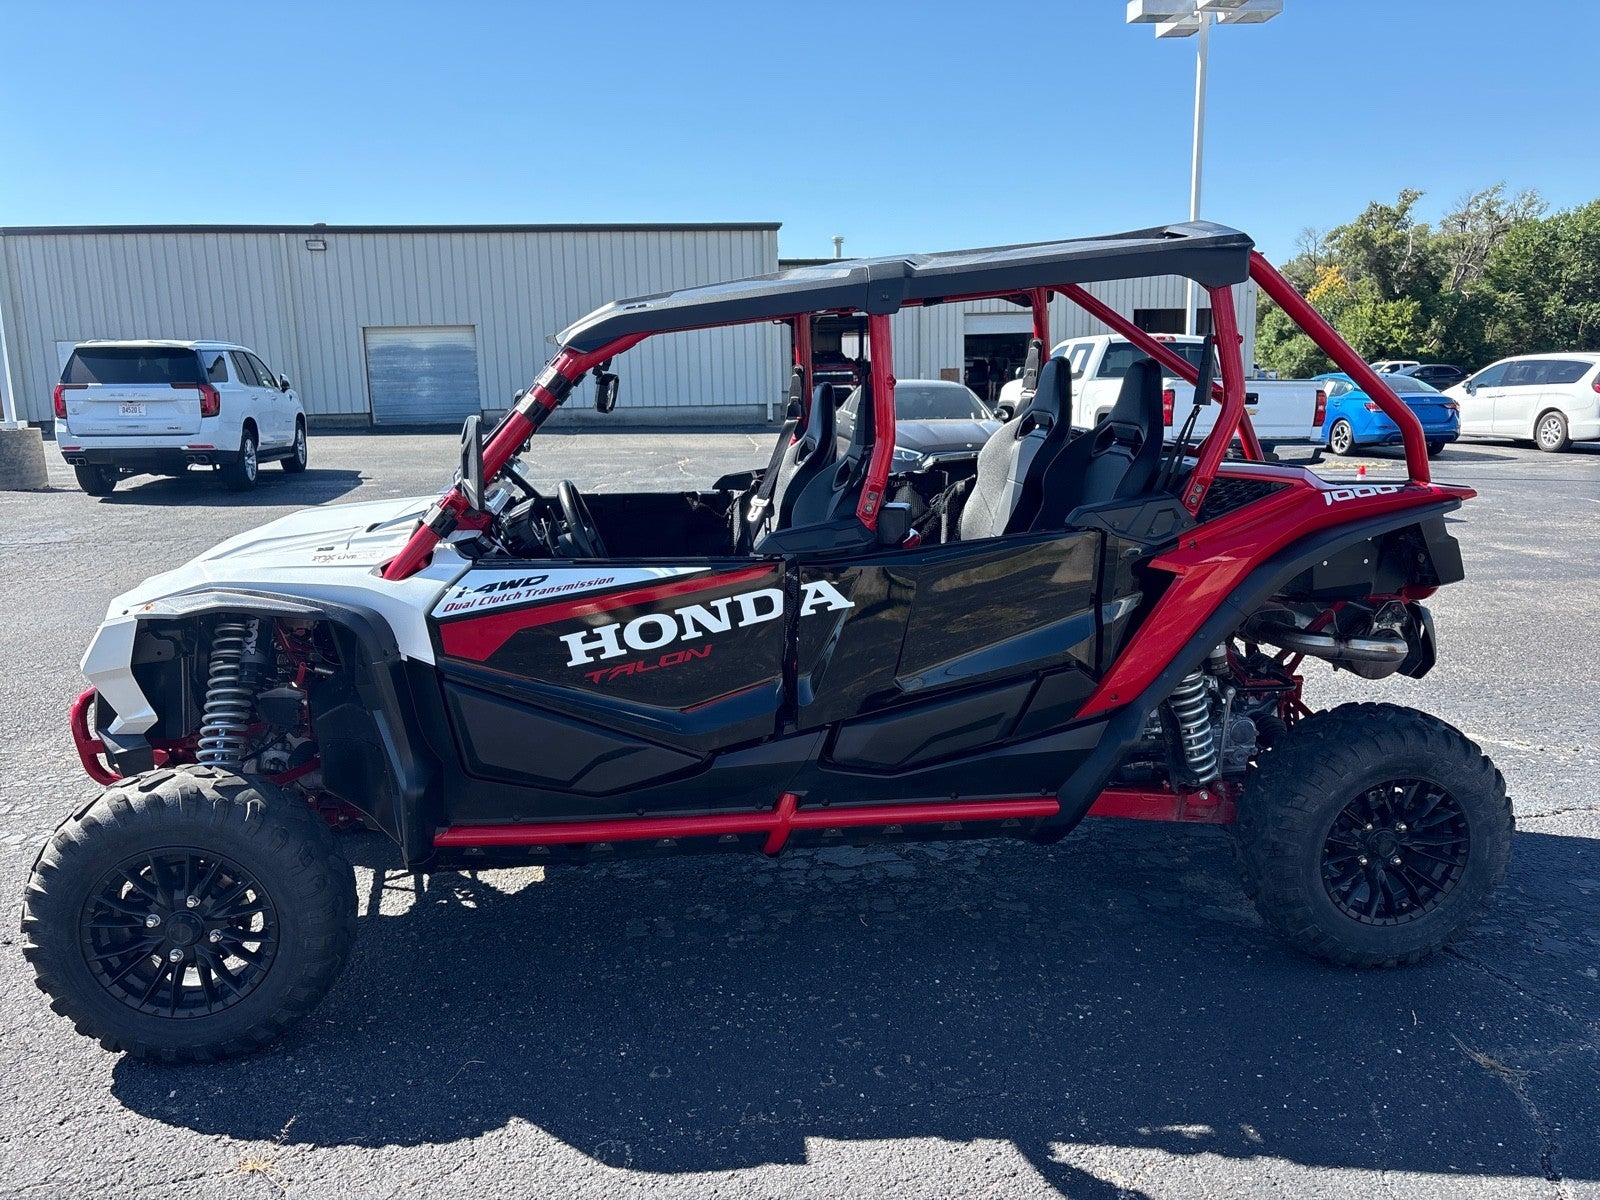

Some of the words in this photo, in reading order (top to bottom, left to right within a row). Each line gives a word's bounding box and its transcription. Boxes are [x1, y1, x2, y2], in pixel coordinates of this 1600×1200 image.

[1321, 486, 1398, 506] 1000
[442, 600, 474, 613] Dual
[478, 591, 523, 607] Clutch
[525, 576, 616, 597] Transmission
[455, 574, 550, 599] i-4WD
[559, 579, 856, 668] HONDA
[583, 643, 713, 684] TALON
